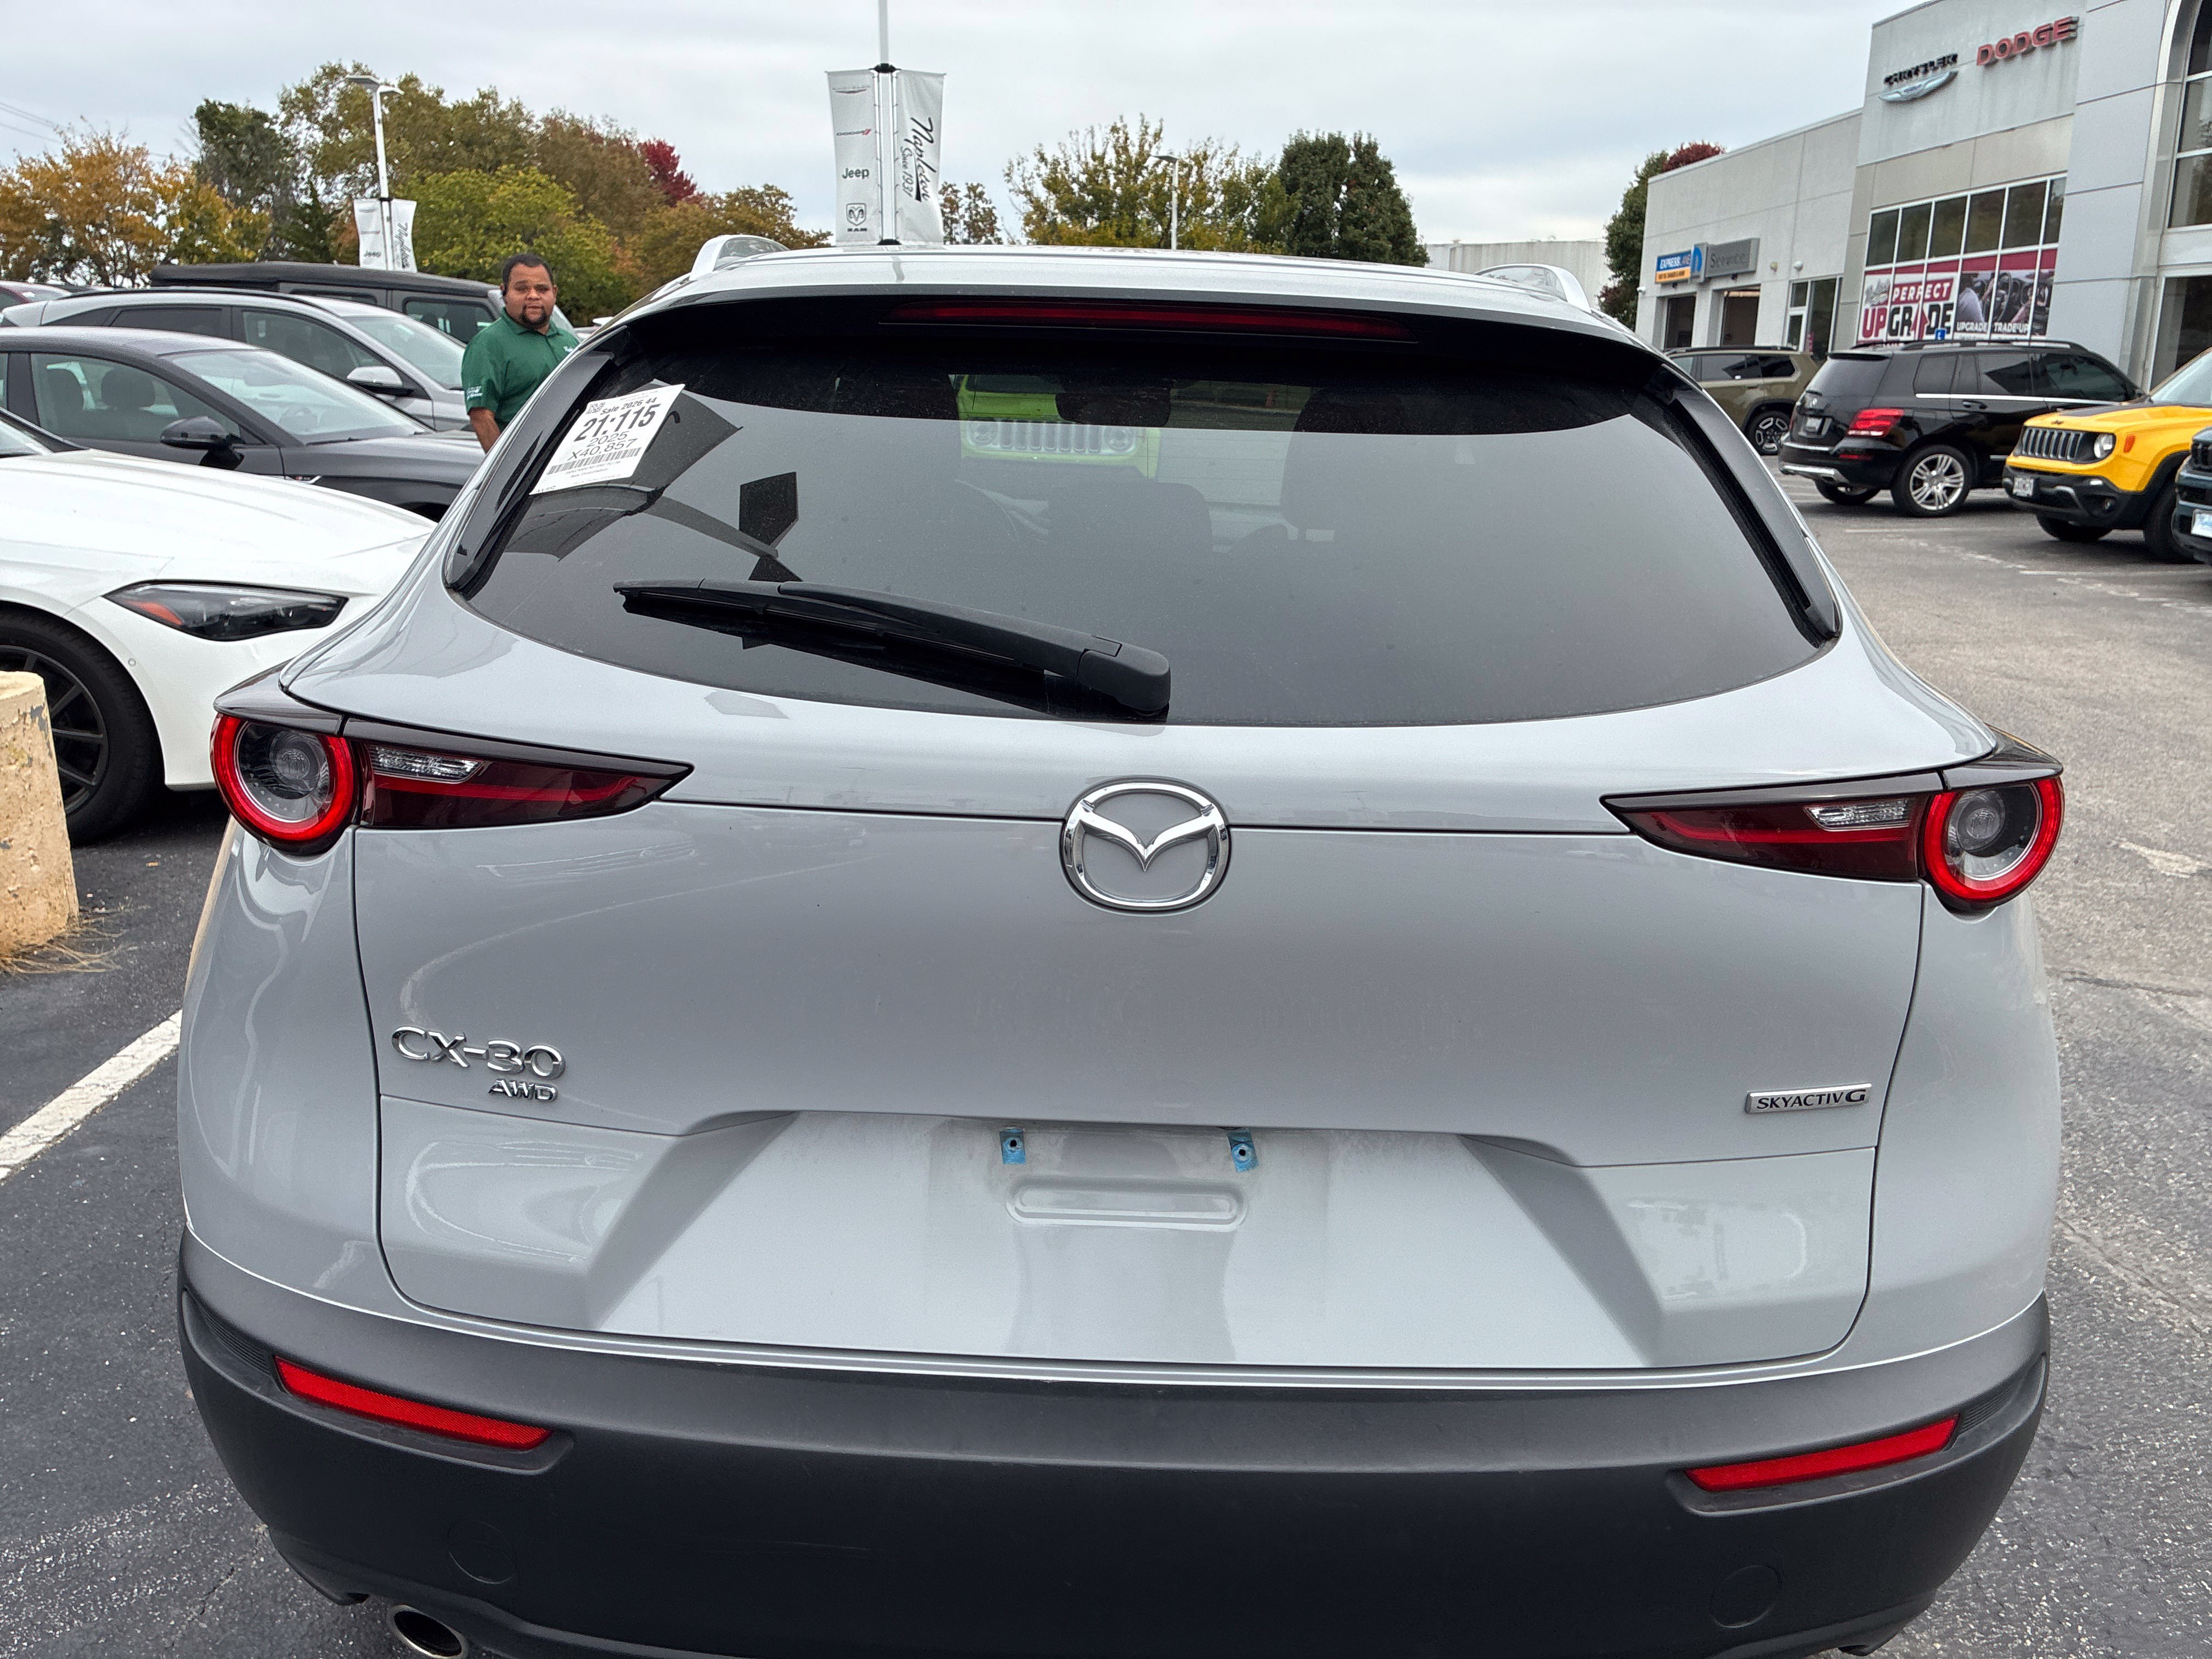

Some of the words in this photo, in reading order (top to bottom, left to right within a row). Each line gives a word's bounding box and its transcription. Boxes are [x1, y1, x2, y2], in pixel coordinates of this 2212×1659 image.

[1976, 16, 2079, 66] DODGE
[904, 117, 936, 201] Napleton
[842, 167, 870, 179] Jeep
[1892, 282, 1951, 302] PERFECT
[1862, 302, 1954, 338] UPGRADE
[1956, 321, 1988, 332] UPGRADE
[600, 404, 619, 415] Sale
[621, 399, 643, 410] 2026
[573, 403, 662, 442] 21:115
[586, 431, 630, 448] 2025
[391, 1025, 566, 1080] CX-30
[488, 1077, 558, 1102] AWD
